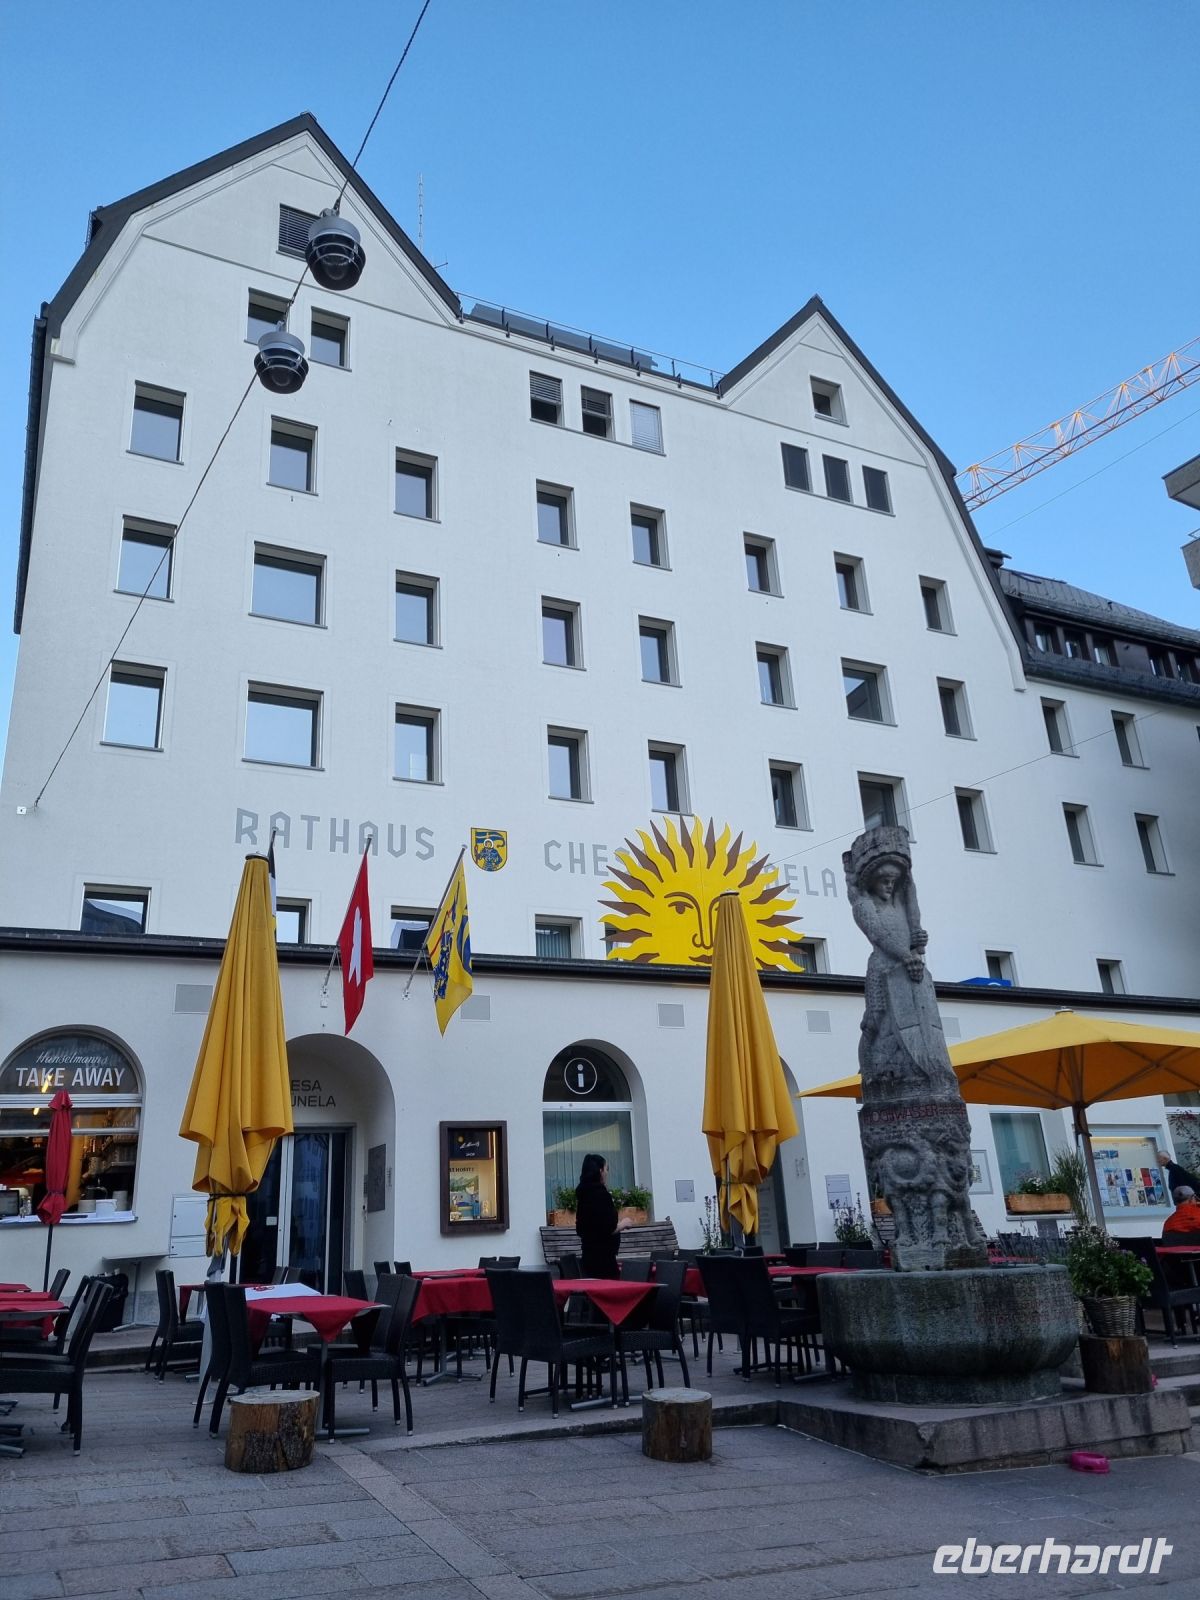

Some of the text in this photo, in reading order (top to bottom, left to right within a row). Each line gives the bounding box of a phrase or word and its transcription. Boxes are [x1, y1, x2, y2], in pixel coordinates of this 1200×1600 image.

[235, 807, 435, 861] RATHAUS
[15, 1067, 126, 1087] TAKE AWAY
